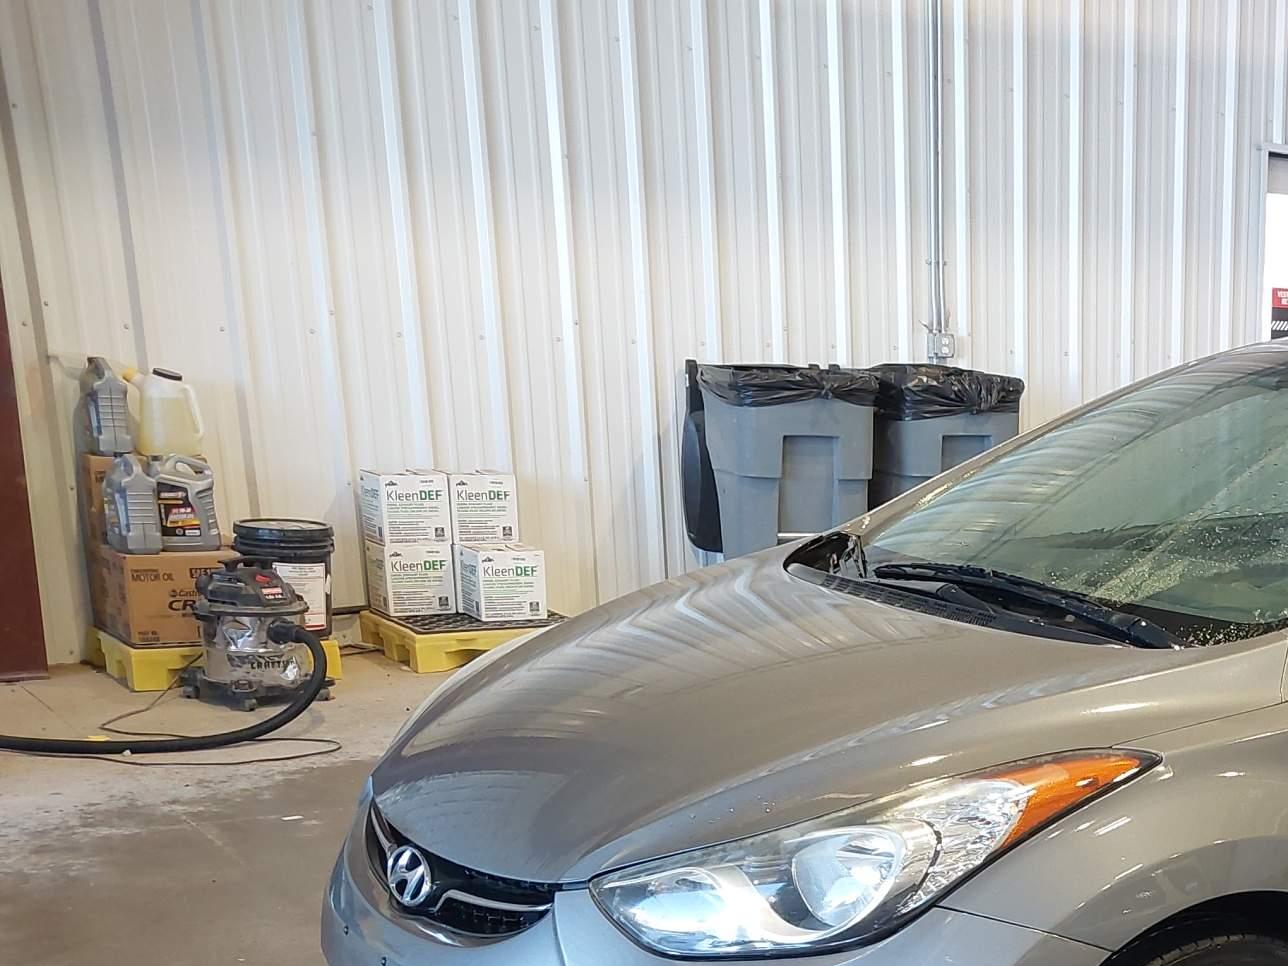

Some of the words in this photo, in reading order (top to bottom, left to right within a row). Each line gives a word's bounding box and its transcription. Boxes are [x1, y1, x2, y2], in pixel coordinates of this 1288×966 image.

[386, 489, 443, 501] KleenDEF
[456, 489, 511, 501] KleenDEF
[391, 559, 447, 572] KleenDEF
[483, 565, 538, 577] KleenDEF
[168, 600, 197, 612] CR
